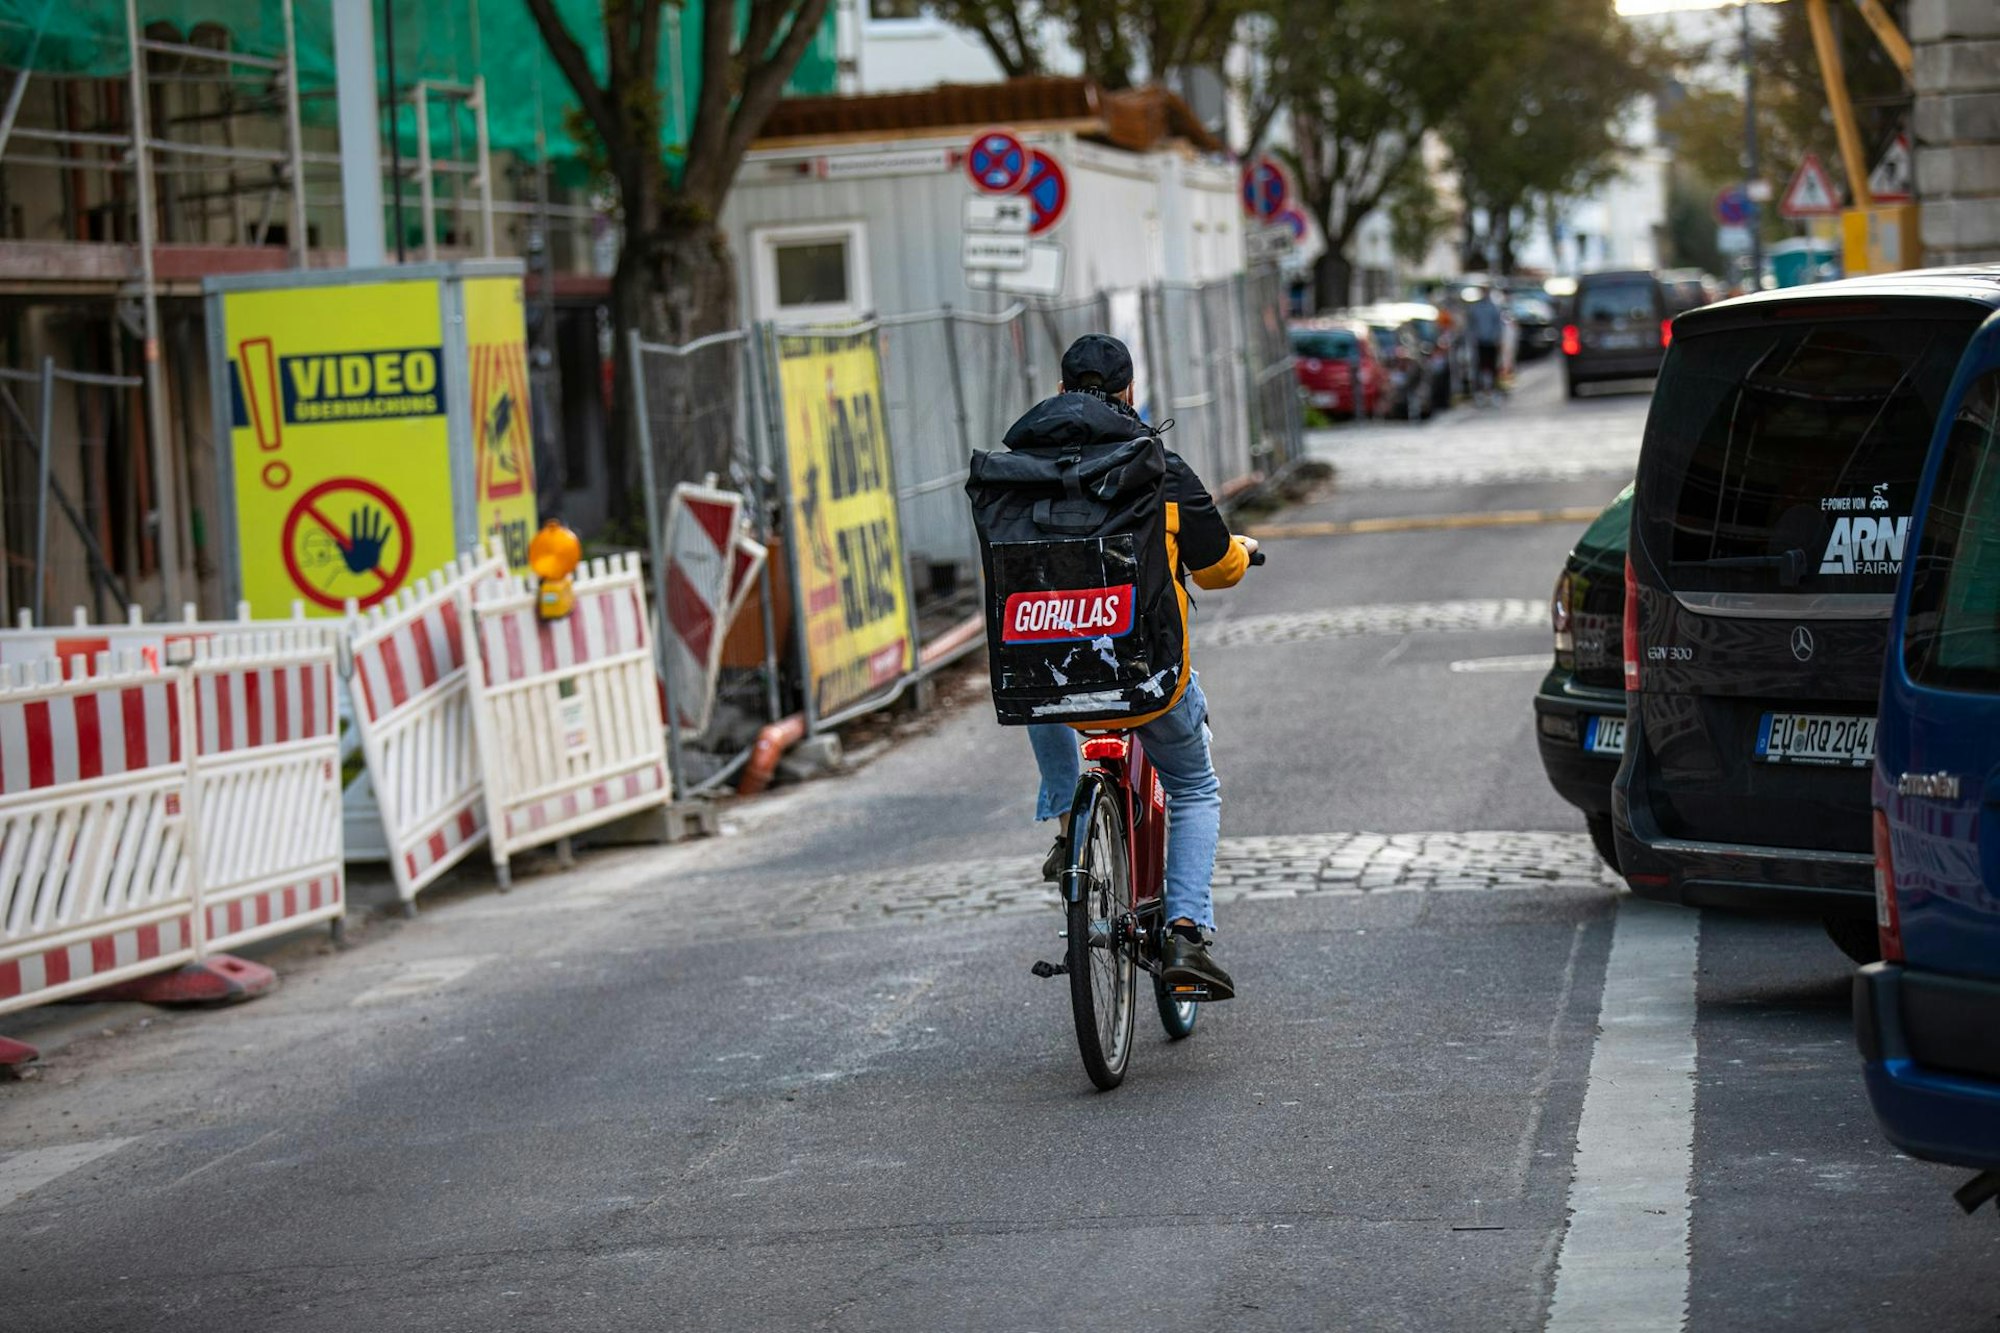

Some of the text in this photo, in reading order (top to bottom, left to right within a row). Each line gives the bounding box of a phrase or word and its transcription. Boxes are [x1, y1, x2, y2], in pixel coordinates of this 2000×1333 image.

[289, 351, 437, 400] VIDEO
[1821, 497, 1867, 511] E-POWER VON
[1819, 516, 1913, 575] ARN
[1014, 594, 1120, 632] GORILLAS
[1669, 647, 1693, 660] 300
[1804, 719, 1832, 753] RQ
